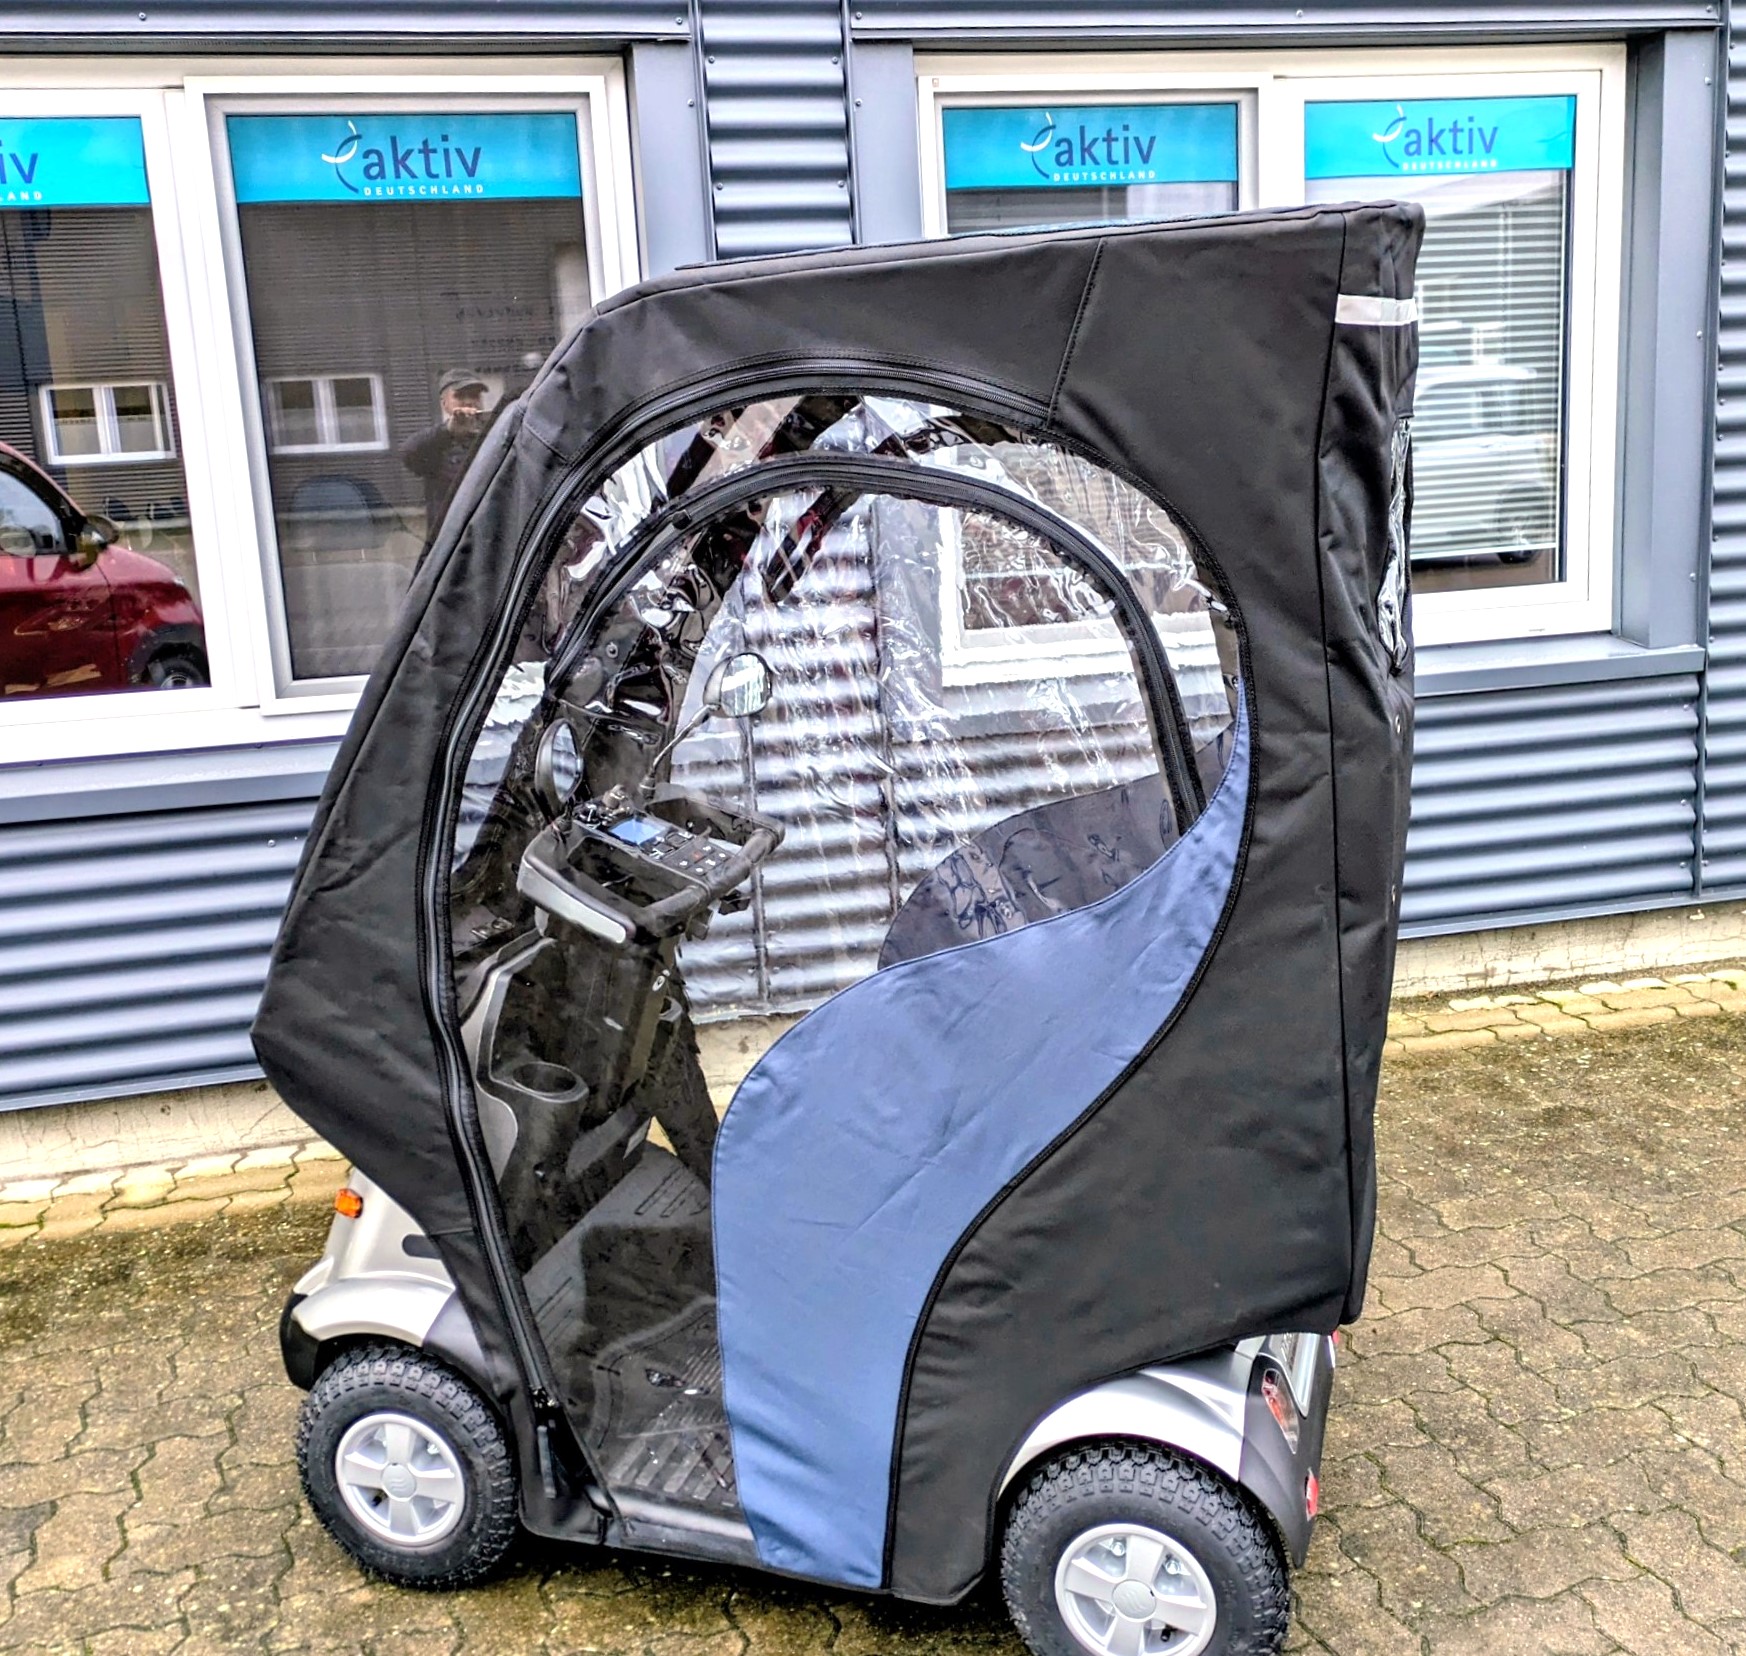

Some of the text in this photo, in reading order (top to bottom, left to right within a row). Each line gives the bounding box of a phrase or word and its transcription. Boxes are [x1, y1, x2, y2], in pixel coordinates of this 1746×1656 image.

[1054, 124, 1157, 167] aktiv
[1403, 116, 1498, 157] aktiv
[362, 134, 482, 180] aktiv
[1402, 159, 1498, 171] DEUTSCHLAND
[1053, 170, 1157, 182] DEUTSCHLAND
[363, 184, 484, 196] DEUTSCHLAND
